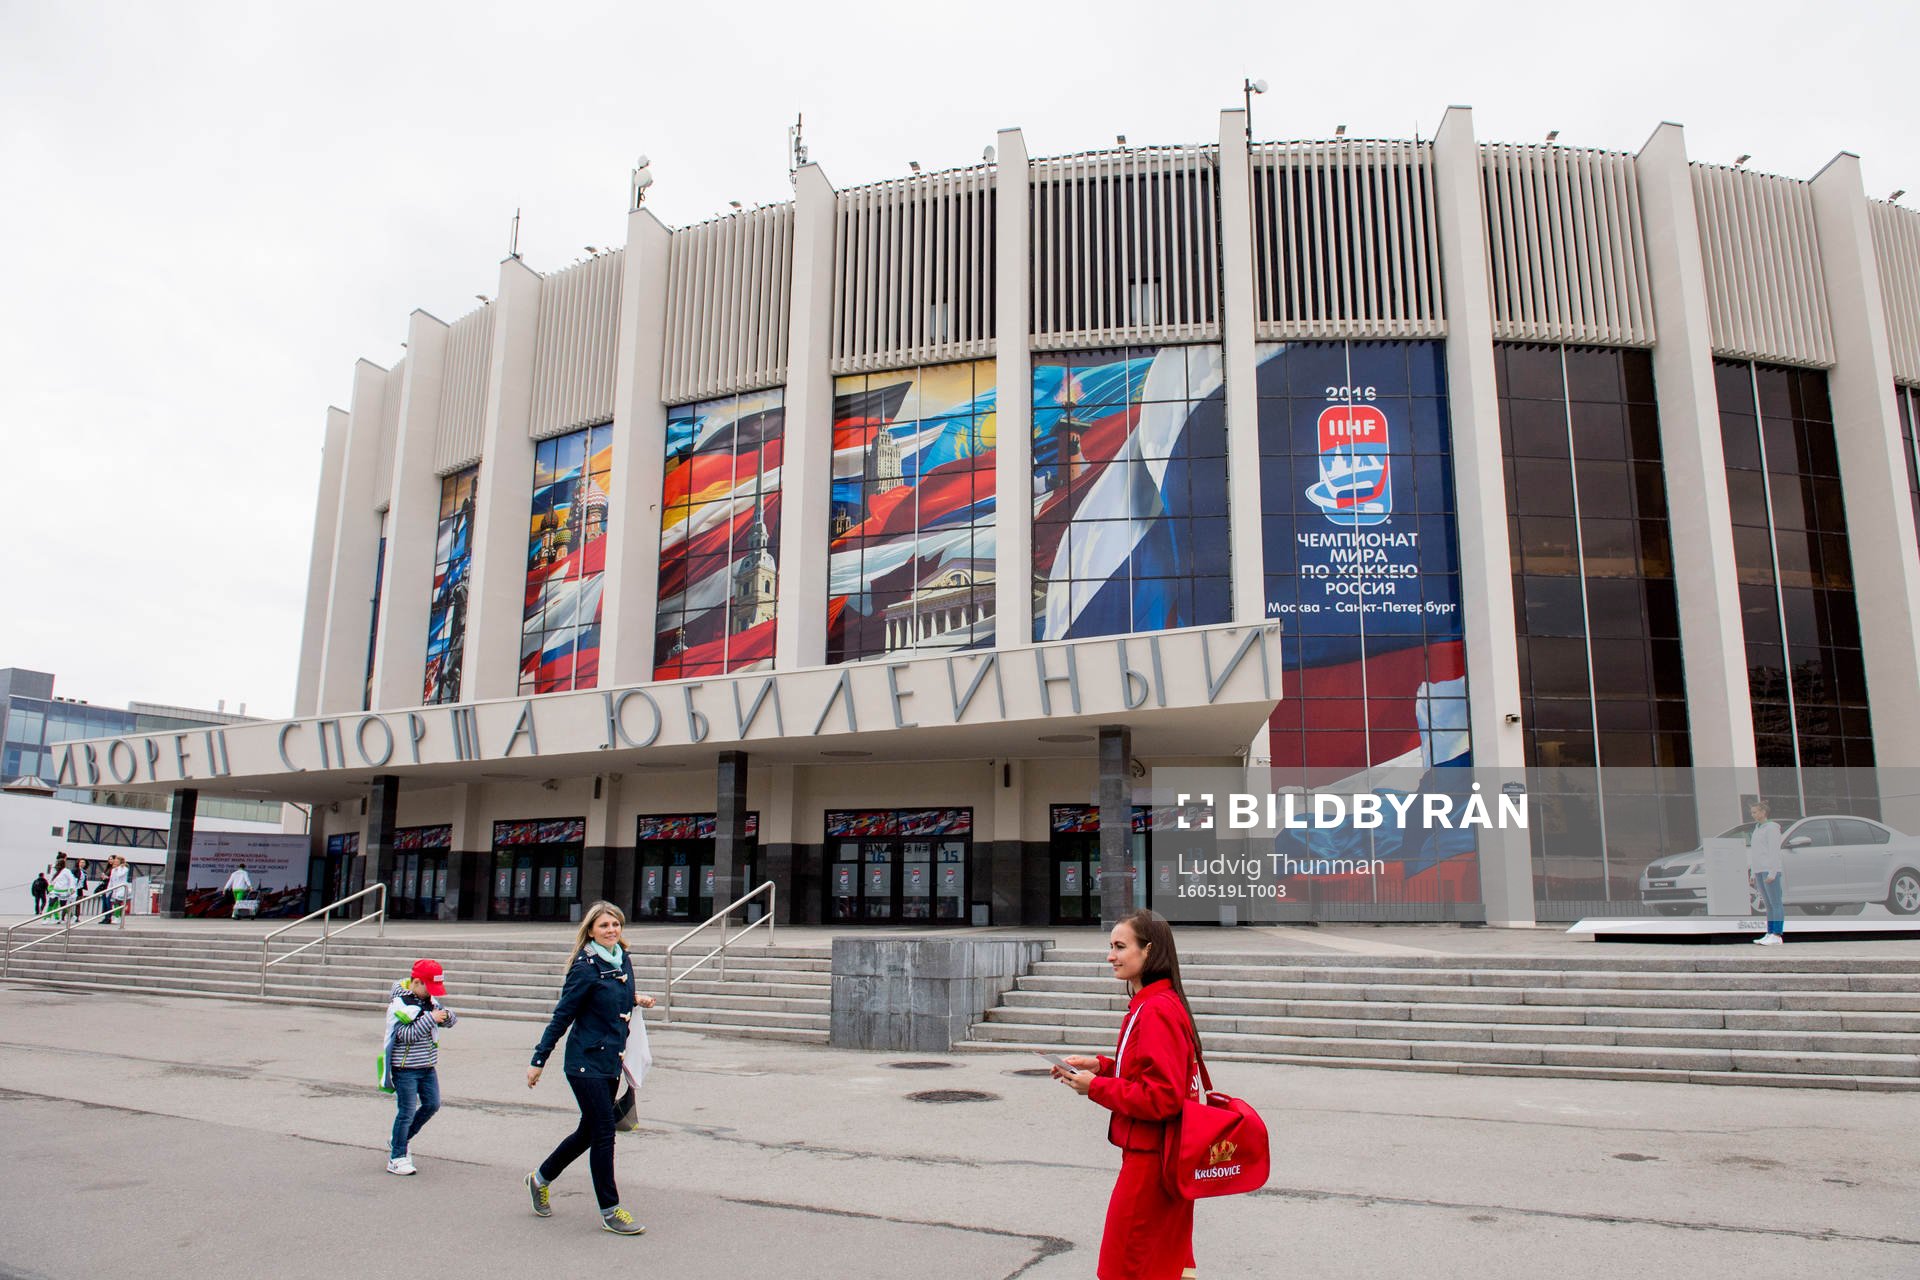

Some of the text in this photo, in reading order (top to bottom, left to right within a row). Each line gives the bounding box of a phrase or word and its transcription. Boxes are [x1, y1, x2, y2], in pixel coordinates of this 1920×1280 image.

[1325, 386, 1377, 401] 2016
[1328, 419, 1376, 436] IIHF
[1297, 532, 1418, 548] ЧЕМПИОНАТ
[1329, 549, 1388, 563] МИРА
[1301, 564, 1418, 579] ПО ХОККЕЮ
[1325, 582, 1396, 595] РОССИЯ
[1268, 601, 1321, 613] Москва
[1335, 600, 1456, 614] Санкт-Петербург
[673, 852, 687, 865] 18
[870, 851, 885, 863] 16
[943, 850, 959, 863] 15
